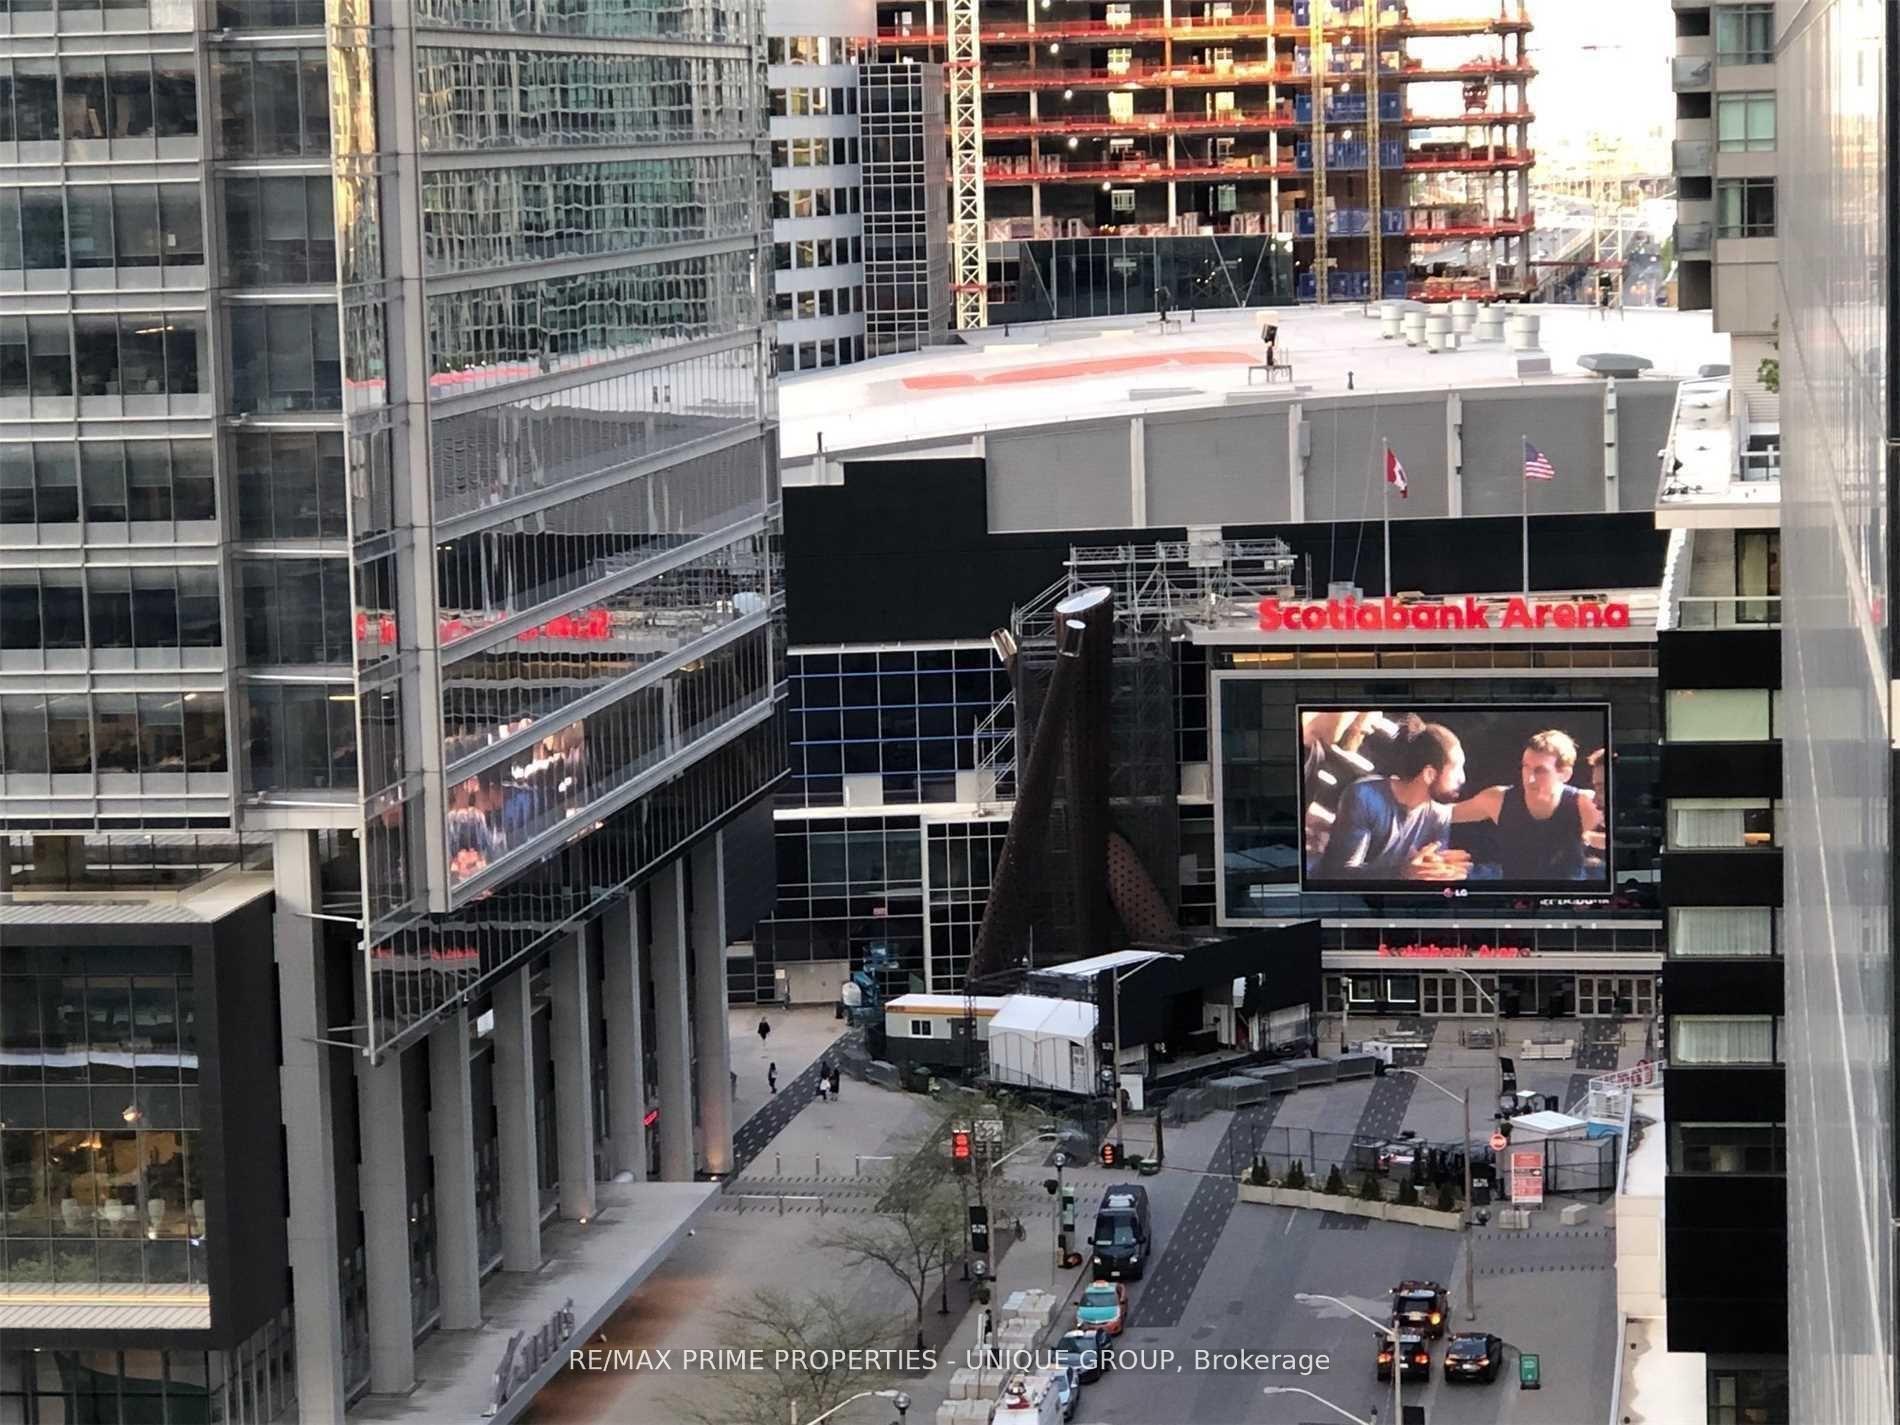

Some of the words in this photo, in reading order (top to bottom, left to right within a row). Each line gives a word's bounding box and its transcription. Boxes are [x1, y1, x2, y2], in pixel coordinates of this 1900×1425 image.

[1259, 597, 1489, 630] Scotiabank
[1502, 599, 1630, 630] Arena
[1455, 889, 1468, 897] LG
